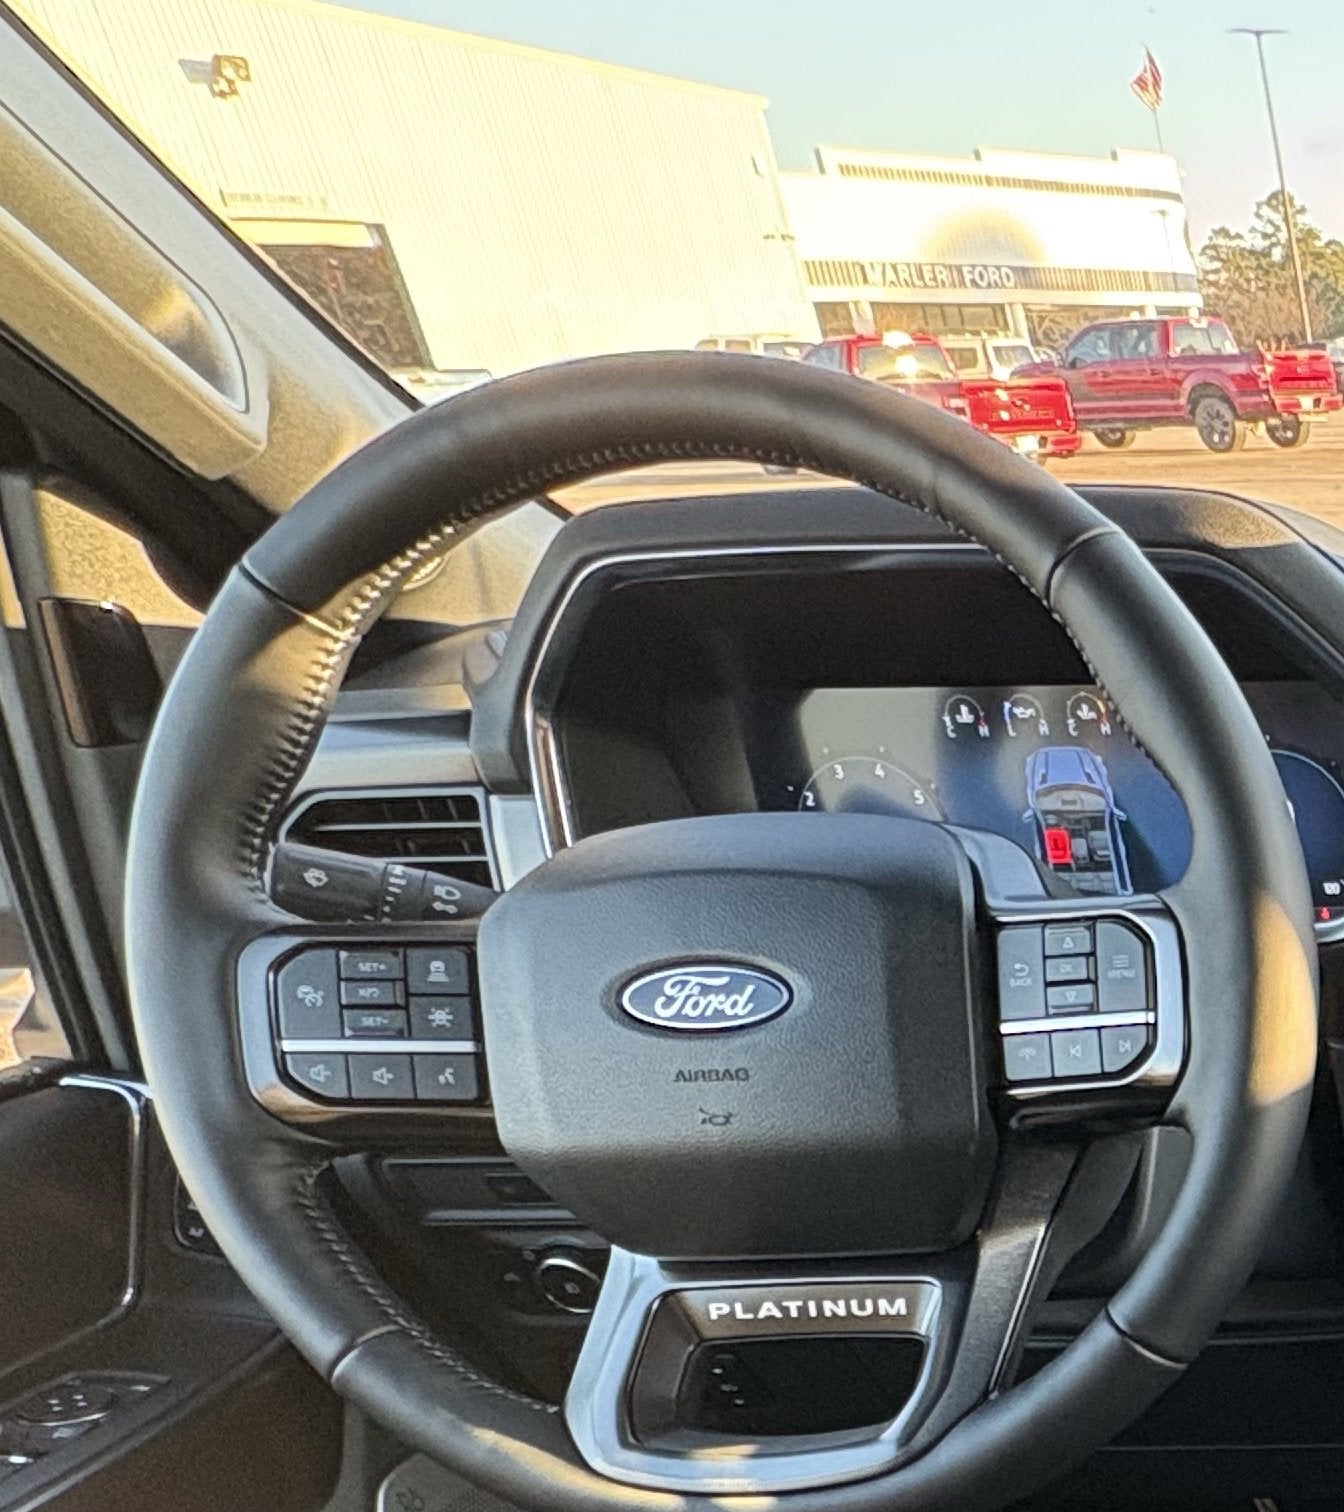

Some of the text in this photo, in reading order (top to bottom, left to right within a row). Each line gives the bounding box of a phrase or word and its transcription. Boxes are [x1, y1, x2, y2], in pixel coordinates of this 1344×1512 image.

[961, 265, 1015, 289] FORD
[832, 763, 886, 780] 3 4
[803, 791, 816, 807] 2
[913, 788, 926, 805] 5
[654, 975, 757, 1018] Ford
[674, 1067, 750, 1083] AIRBAG
[708, 1297, 908, 1321] PLATINUM
